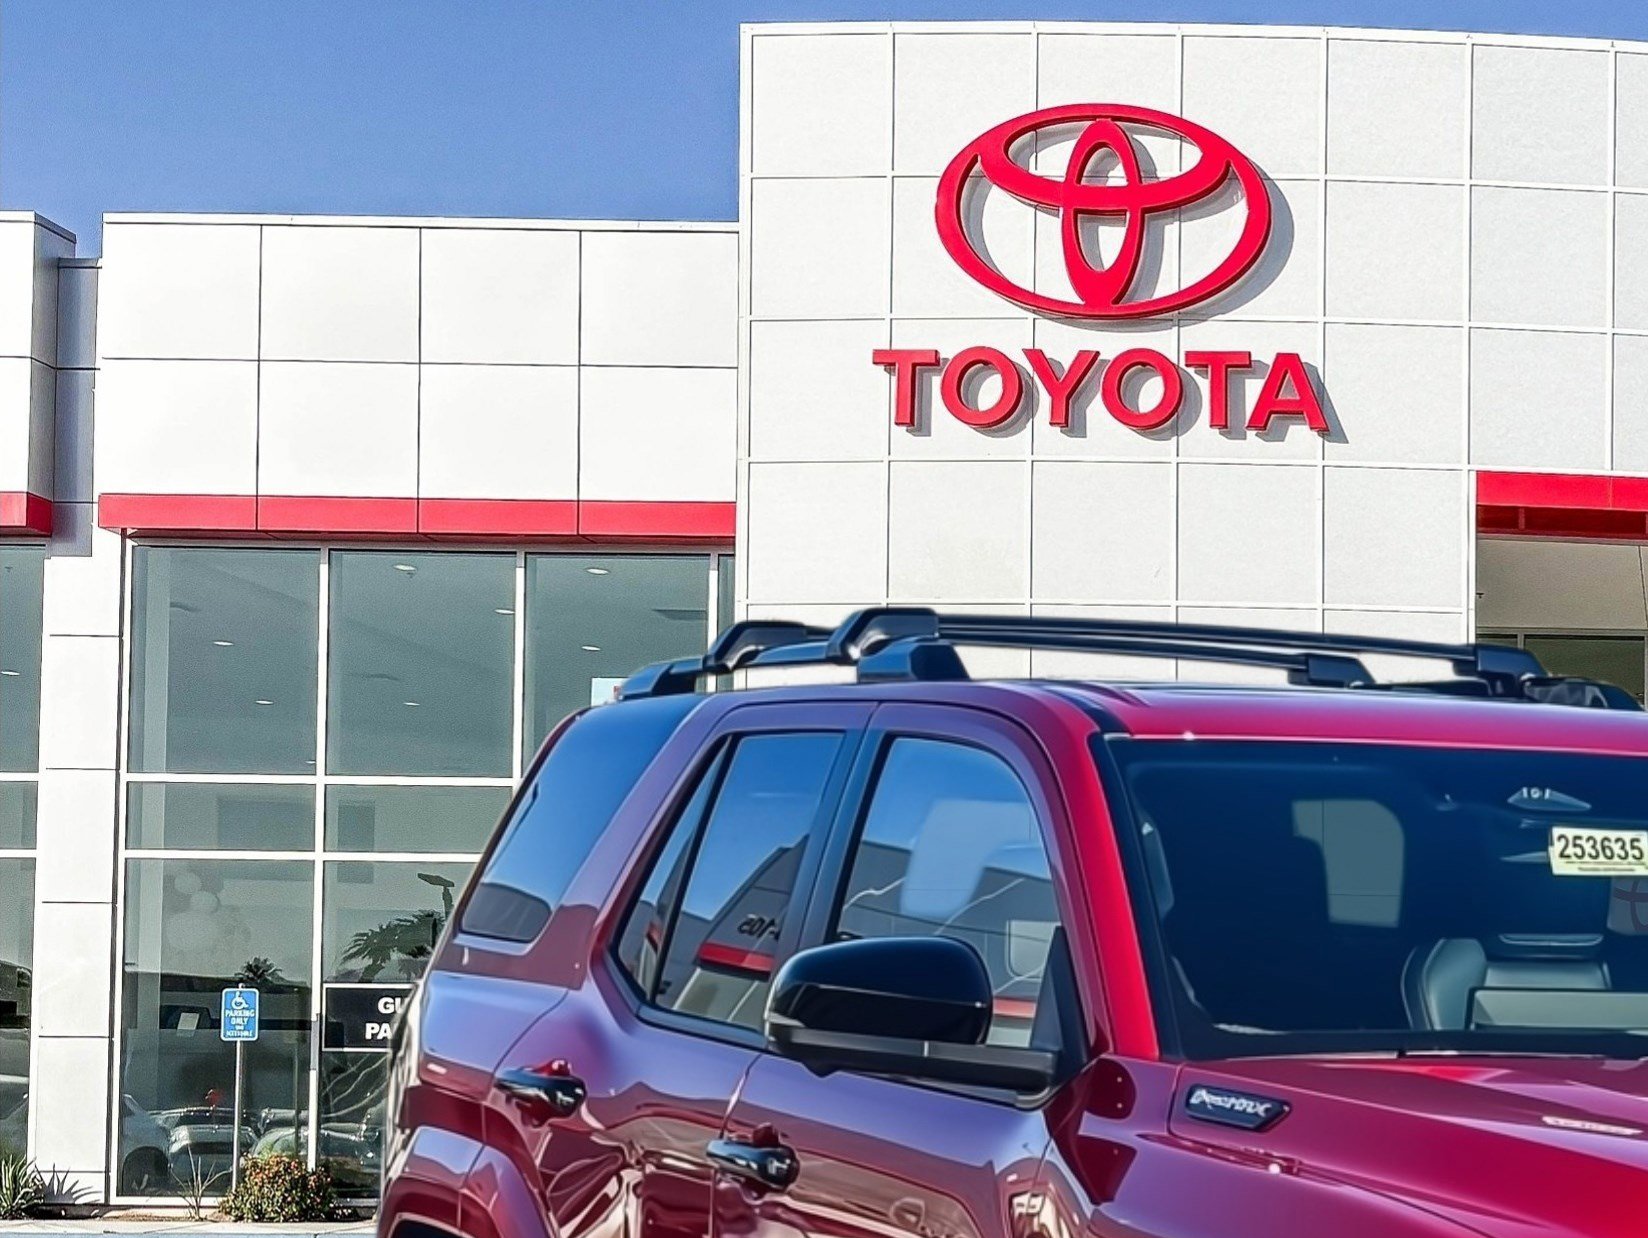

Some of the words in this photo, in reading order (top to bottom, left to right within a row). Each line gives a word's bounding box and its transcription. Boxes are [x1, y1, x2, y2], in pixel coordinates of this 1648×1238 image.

[872, 346, 1330, 434] TOYOTA
[1556, 833, 1644, 860] 253635
[225, 1009, 255, 1018] PARKING
[230, 1017, 249, 1025] ONLY
